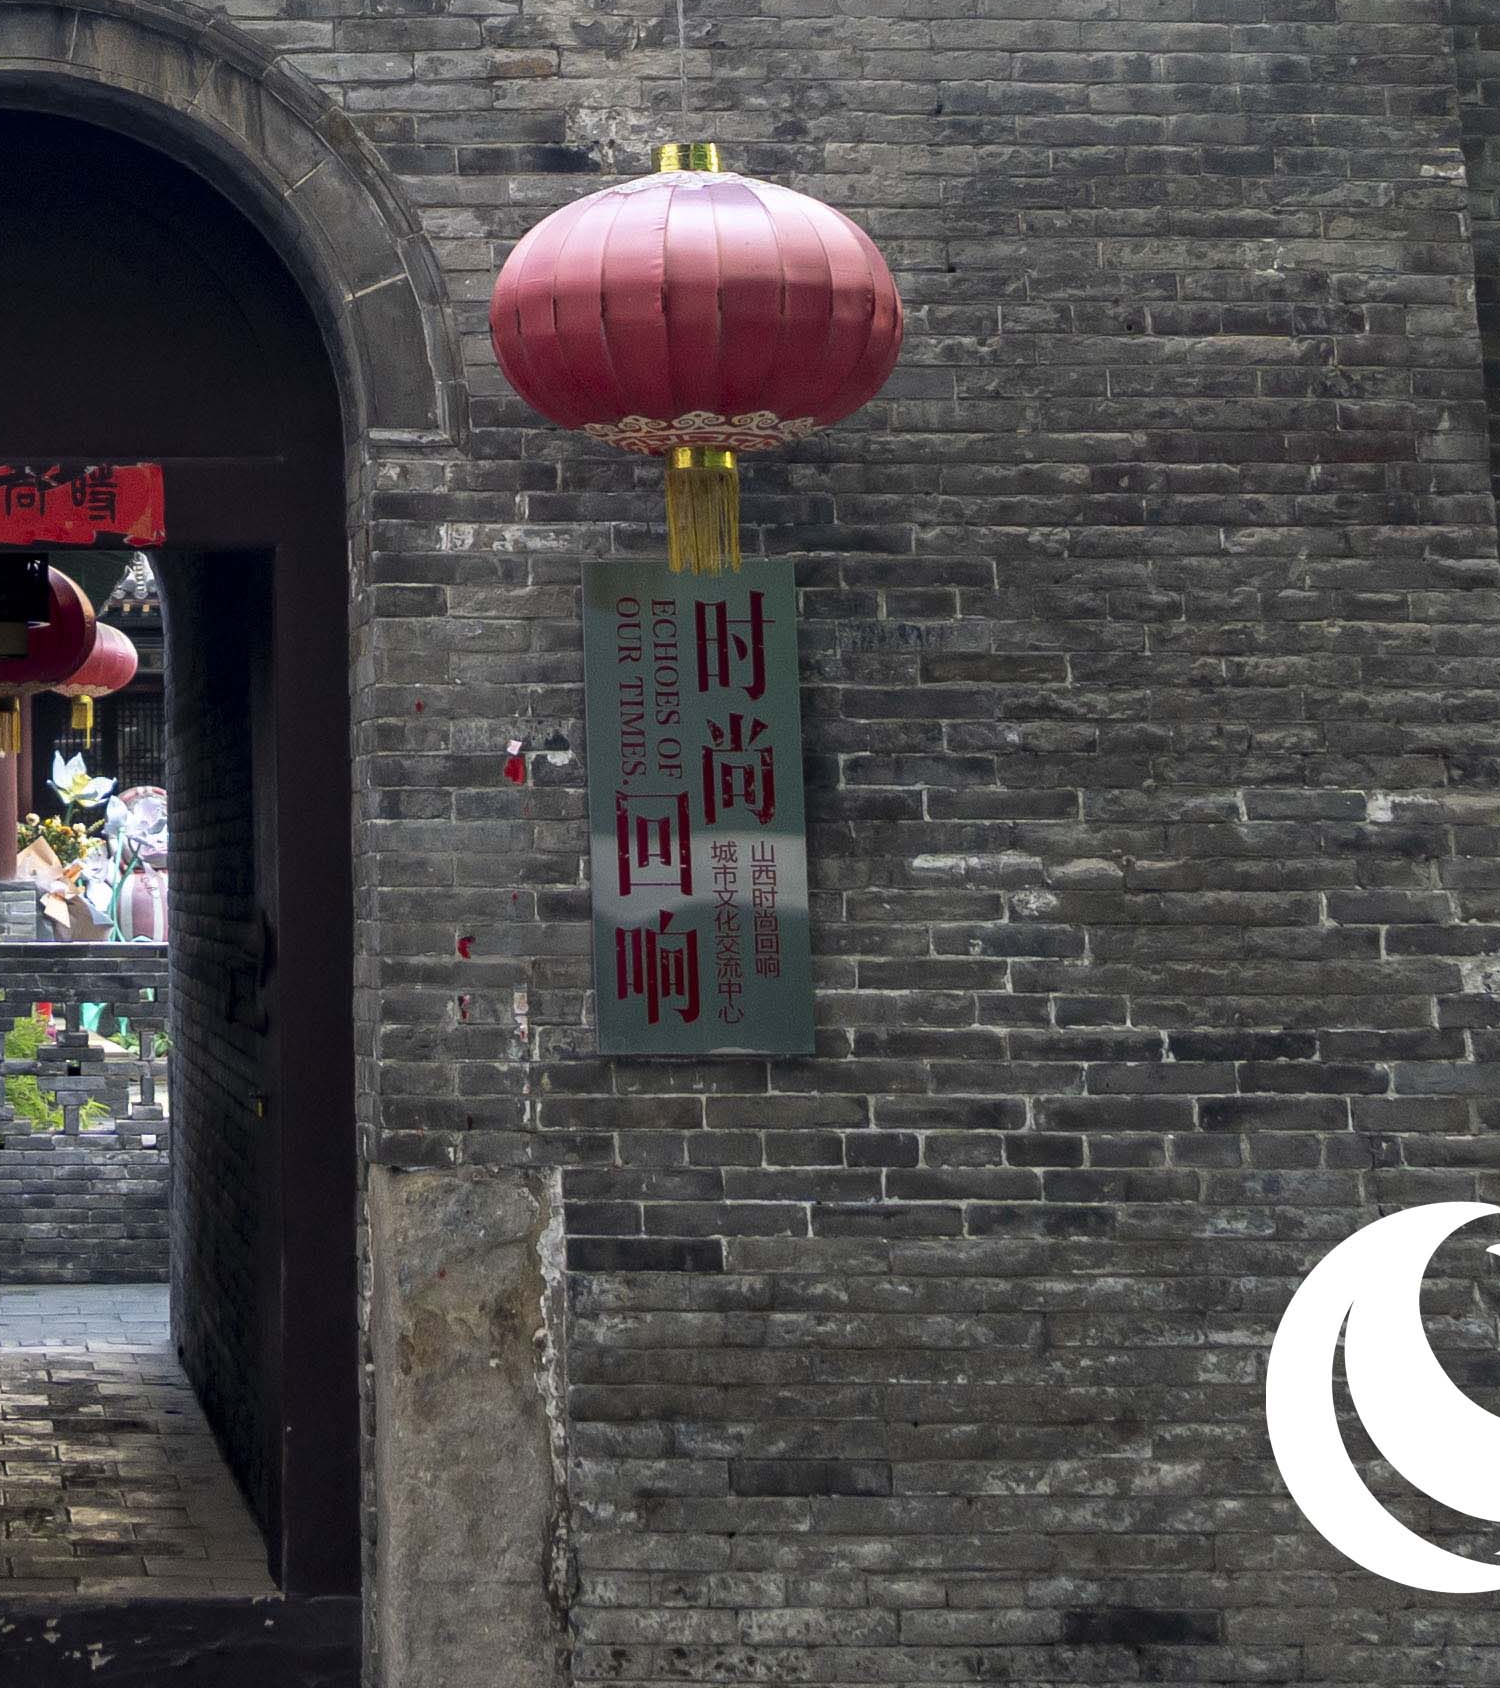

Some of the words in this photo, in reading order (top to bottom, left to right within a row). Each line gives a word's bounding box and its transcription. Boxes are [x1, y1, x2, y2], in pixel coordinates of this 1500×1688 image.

[616, 597, 642, 664] OUR
[651, 599, 681, 726] ECHOES
[619, 676, 647, 785] TIMES.
[657, 737, 683, 779] OF
[709, 839, 745, 1025] 城市文化交流中心
[750, 842, 781, 979] 山西时尚回响
